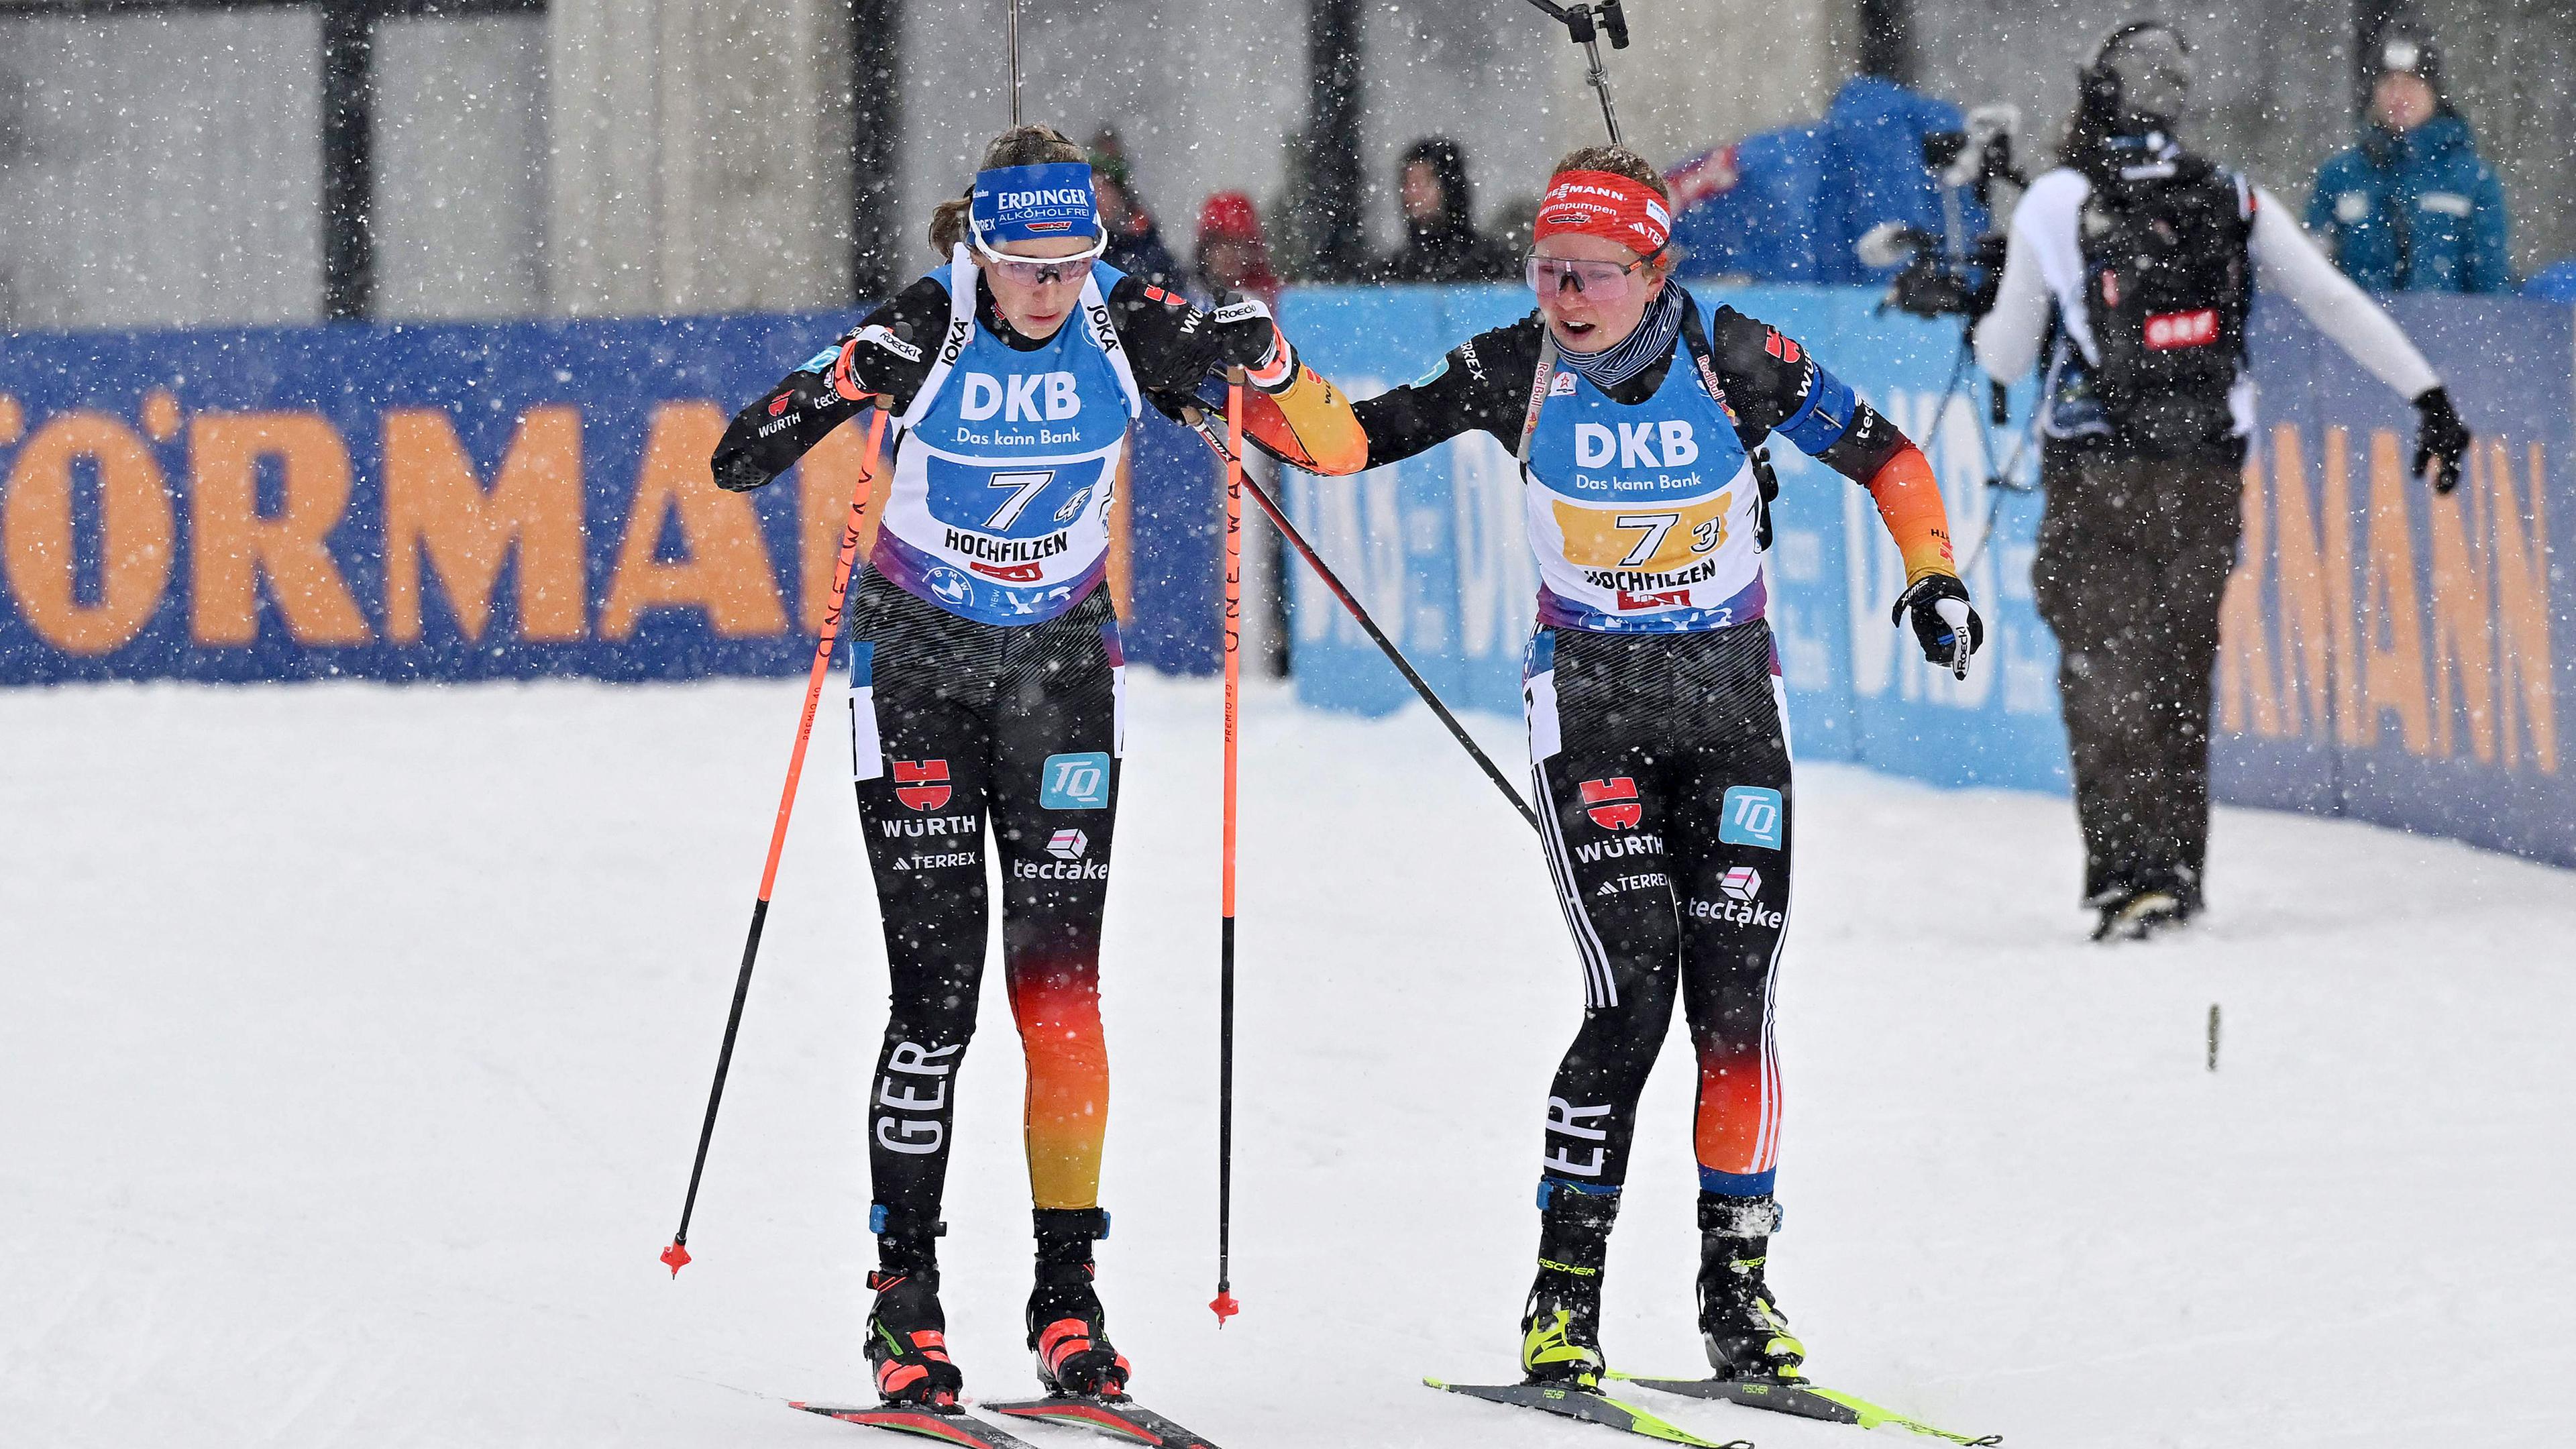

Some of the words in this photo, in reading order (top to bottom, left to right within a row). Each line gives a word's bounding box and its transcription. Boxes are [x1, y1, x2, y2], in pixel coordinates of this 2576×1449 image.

[998, 189, 1089, 210] ERDINGER
[999, 208, 1089, 223] ALKOHOLFREI
[941, 317, 968, 367] JOKA
[1087, 305, 1119, 354] JOKA
[960, 371, 1081, 422] DKB
[758, 412, 802, 438] WÜRTH
[957, 427, 989, 445] Das
[994, 429, 1035, 446] kann
[1040, 431, 1081, 445] Bank
[1575, 420, 1699, 468] DKB
[1576, 474, 1607, 490] Das
[1613, 476, 1654, 491] kann
[1660, 472, 1702, 490] Bank
[981, 470, 1056, 531] 7
[1053, 484, 1094, 523] 4
[945, 529, 1068, 562] HOCHFILZEN
[1614, 513, 1681, 568] 7
[1690, 516, 1721, 554] 3
[934, 570, 969, 592] BMW
[1584, 557, 1716, 591] HOCHFILZEN
[991, 589, 1000, 607] NEW
[1055, 761, 1101, 802] TQ
[882, 815, 977, 838] WÜRTH
[1735, 794, 1776, 841] TQ
[911, 852, 976, 870] TERREX
[1575, 835, 1664, 864] WÜRTH
[1014, 858, 1108, 880] tectake
[1617, 873, 1669, 892] TERREX
[1688, 896, 1782, 929] tectake
[876, 1041, 961, 1155] GER
[1537, 1256, 1596, 1277] FISCHER
[1742, 1384, 1768, 1396] FISCHER
